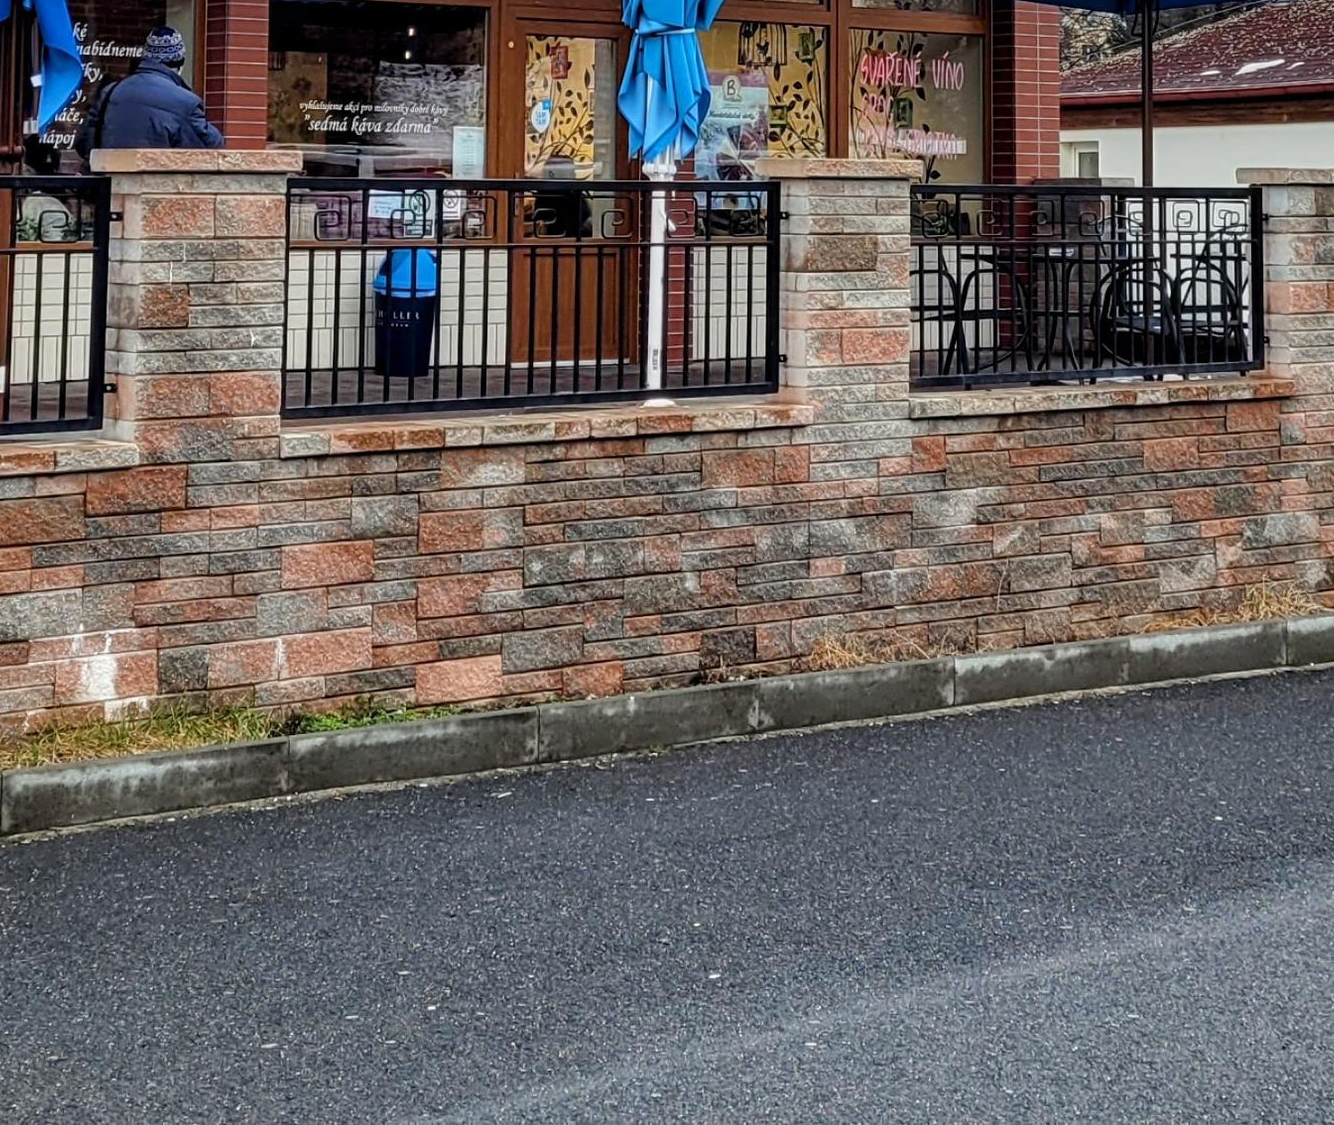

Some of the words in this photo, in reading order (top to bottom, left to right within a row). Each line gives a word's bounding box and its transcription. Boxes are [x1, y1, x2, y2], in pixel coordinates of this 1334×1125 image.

[861, 51, 923, 89] SVAŘENÉ
[932, 51, 965, 92] VÍNO
[360, 104, 374, 114] pro
[351, 115, 383, 136] káva
